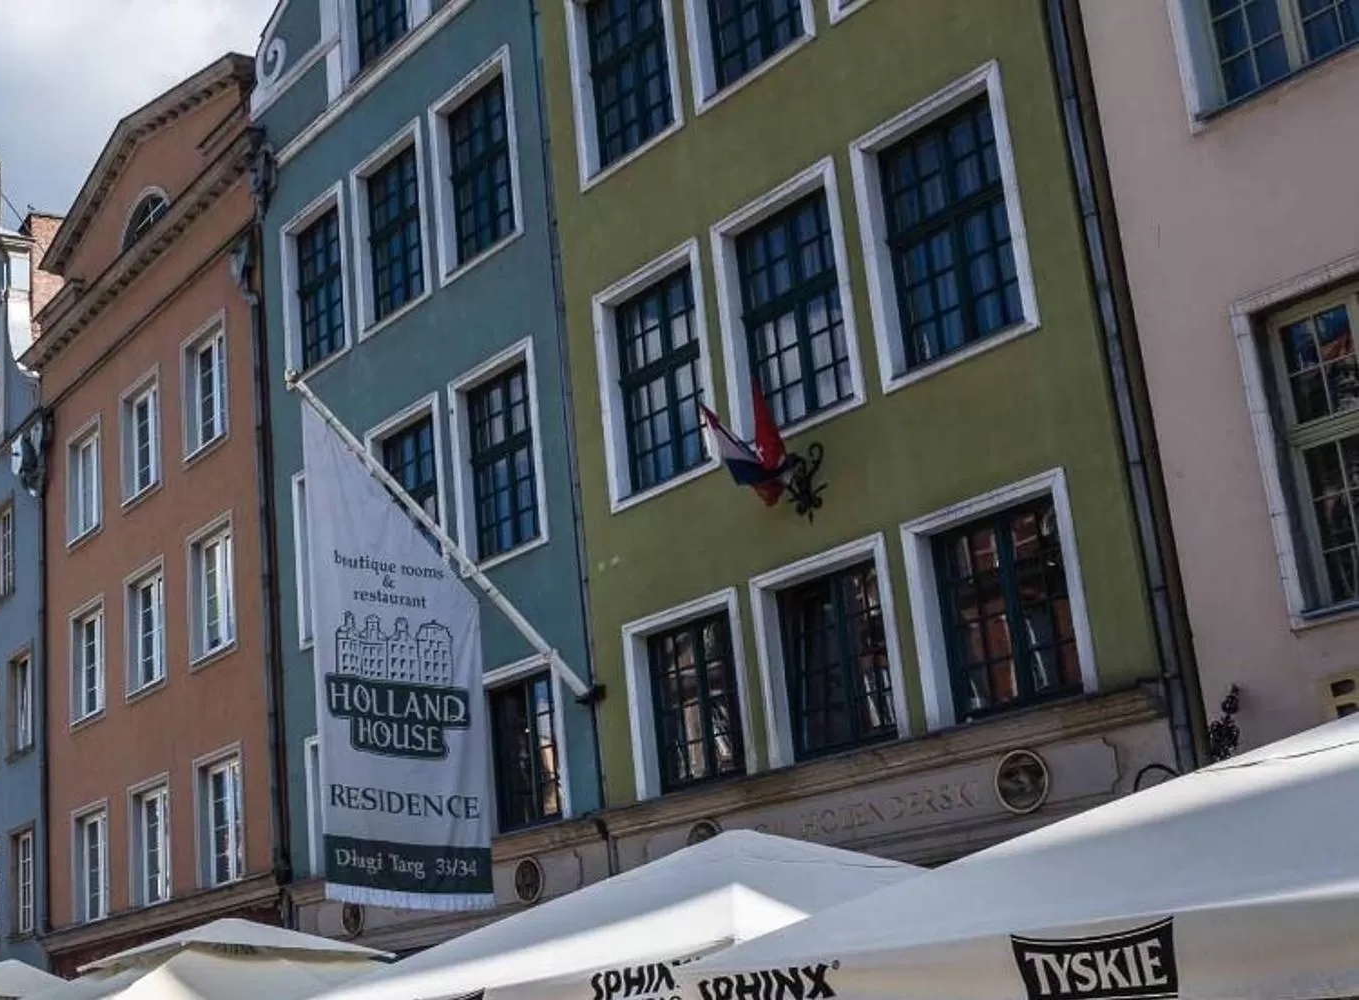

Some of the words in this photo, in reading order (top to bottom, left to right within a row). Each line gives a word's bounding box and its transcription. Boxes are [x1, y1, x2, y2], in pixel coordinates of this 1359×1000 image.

[382, 575, 396, 589] &
[401, 564, 444, 579] rooms
[353, 588, 427, 609] restaurant
[330, 682, 467, 722] HOLLAND
[358, 717, 441, 752] HOUSE
[330, 784, 481, 819] RESIDENCE
[388, 853, 426, 880] Targ
[435, 858, 478, 877] 33/34
[1024, 937, 1169, 996] TYSKIE
